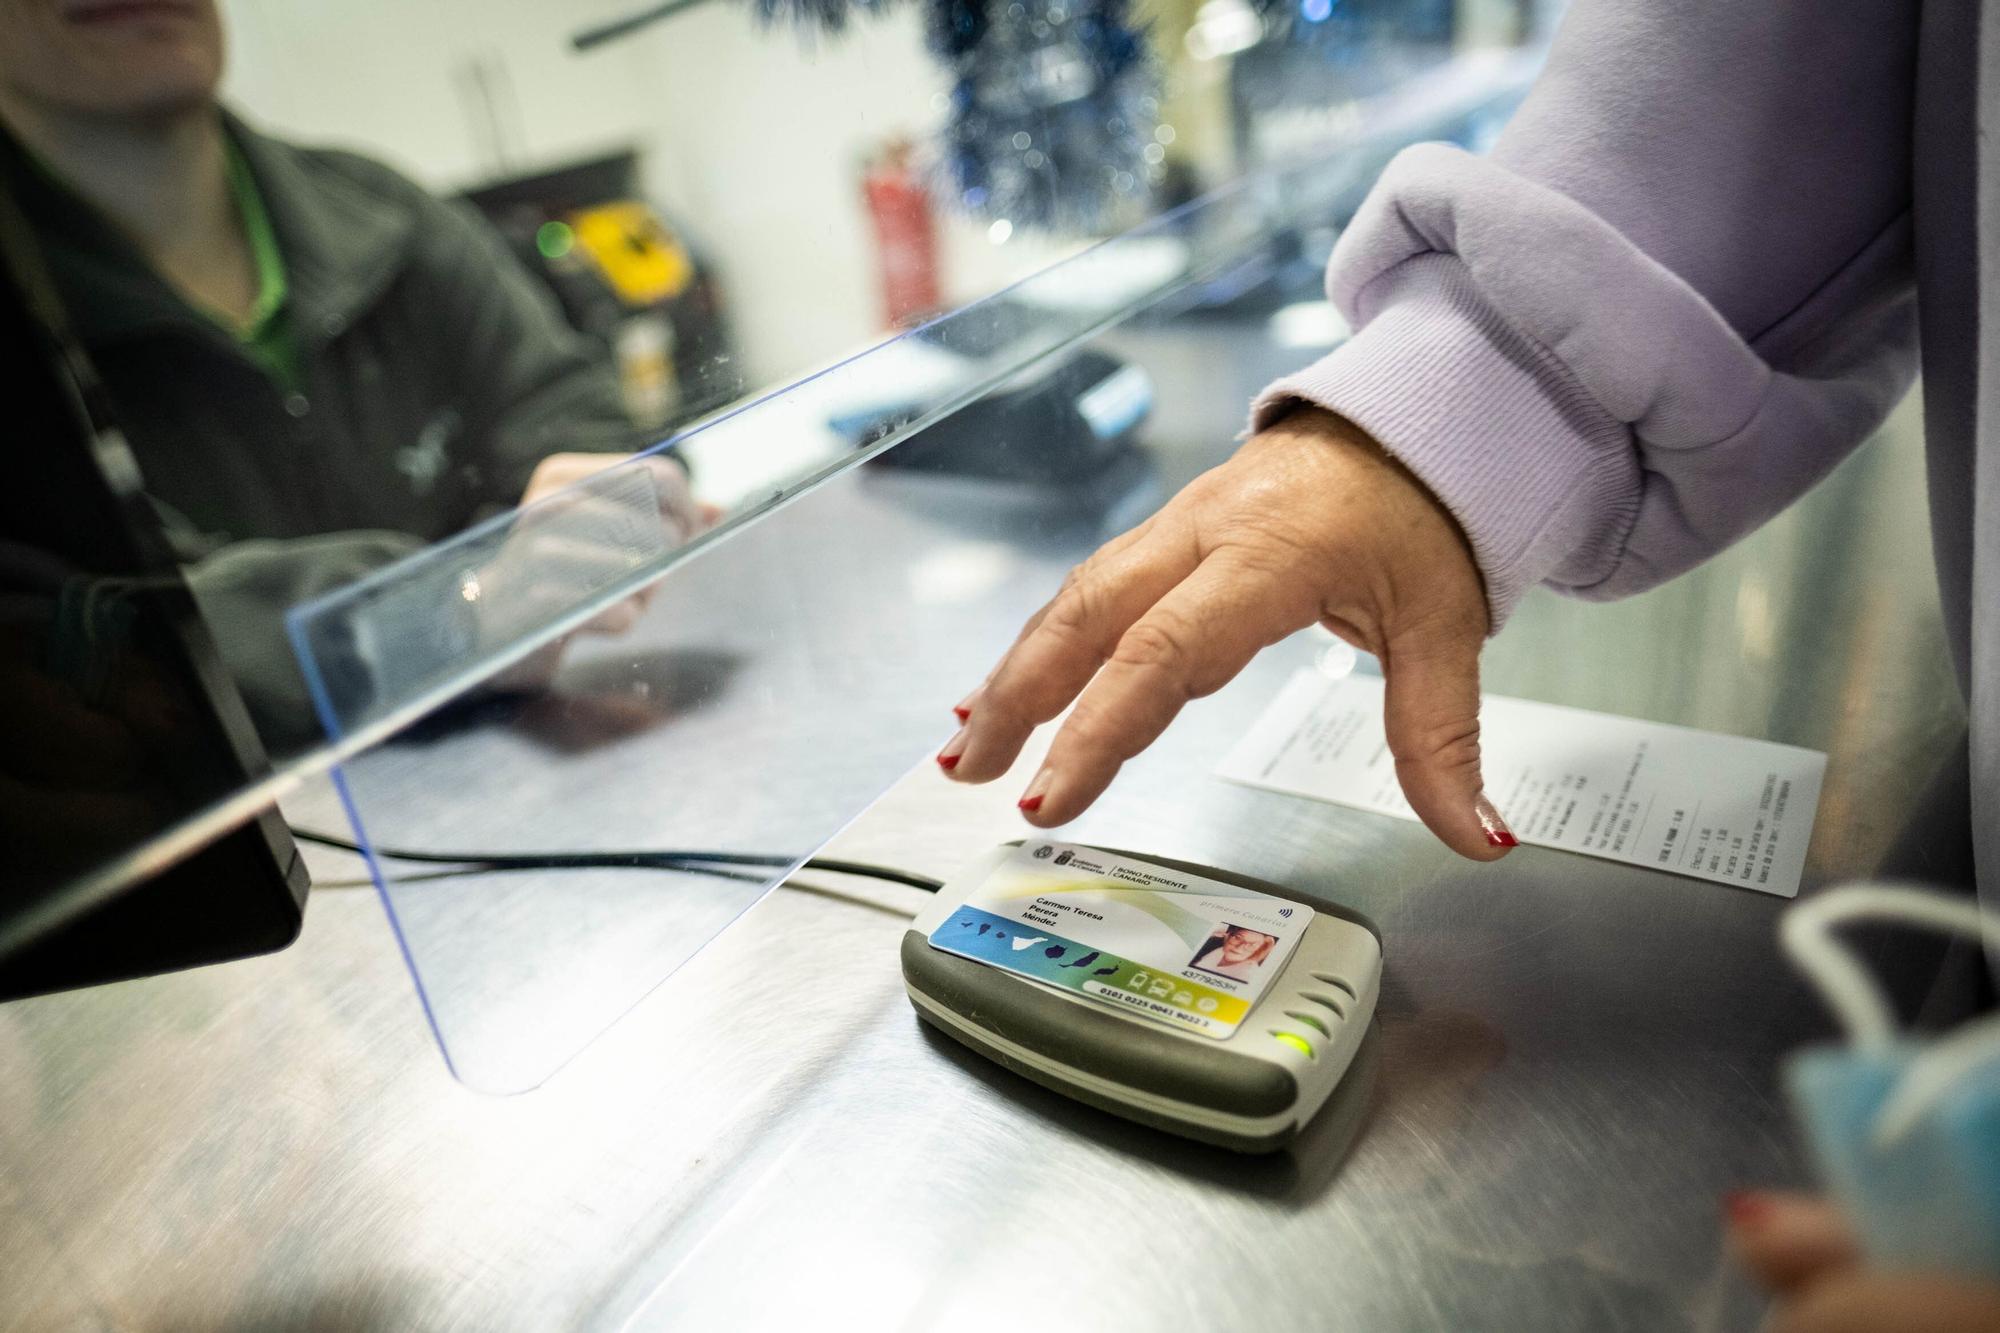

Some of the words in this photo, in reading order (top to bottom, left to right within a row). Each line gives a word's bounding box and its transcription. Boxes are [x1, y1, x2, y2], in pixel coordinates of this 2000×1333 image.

[1113, 872, 1152, 886] CANARIO
[1117, 866, 1143, 878] BONO
[1142, 872, 1189, 890] RESIDENTE
[1029, 904, 1059, 918] Perera
[1036, 897, 1072, 912] Carmen
[1073, 907, 1104, 921] Teresa
[1021, 912, 1057, 927] Méndez
[1100, 987, 1123, 1000] 0101
